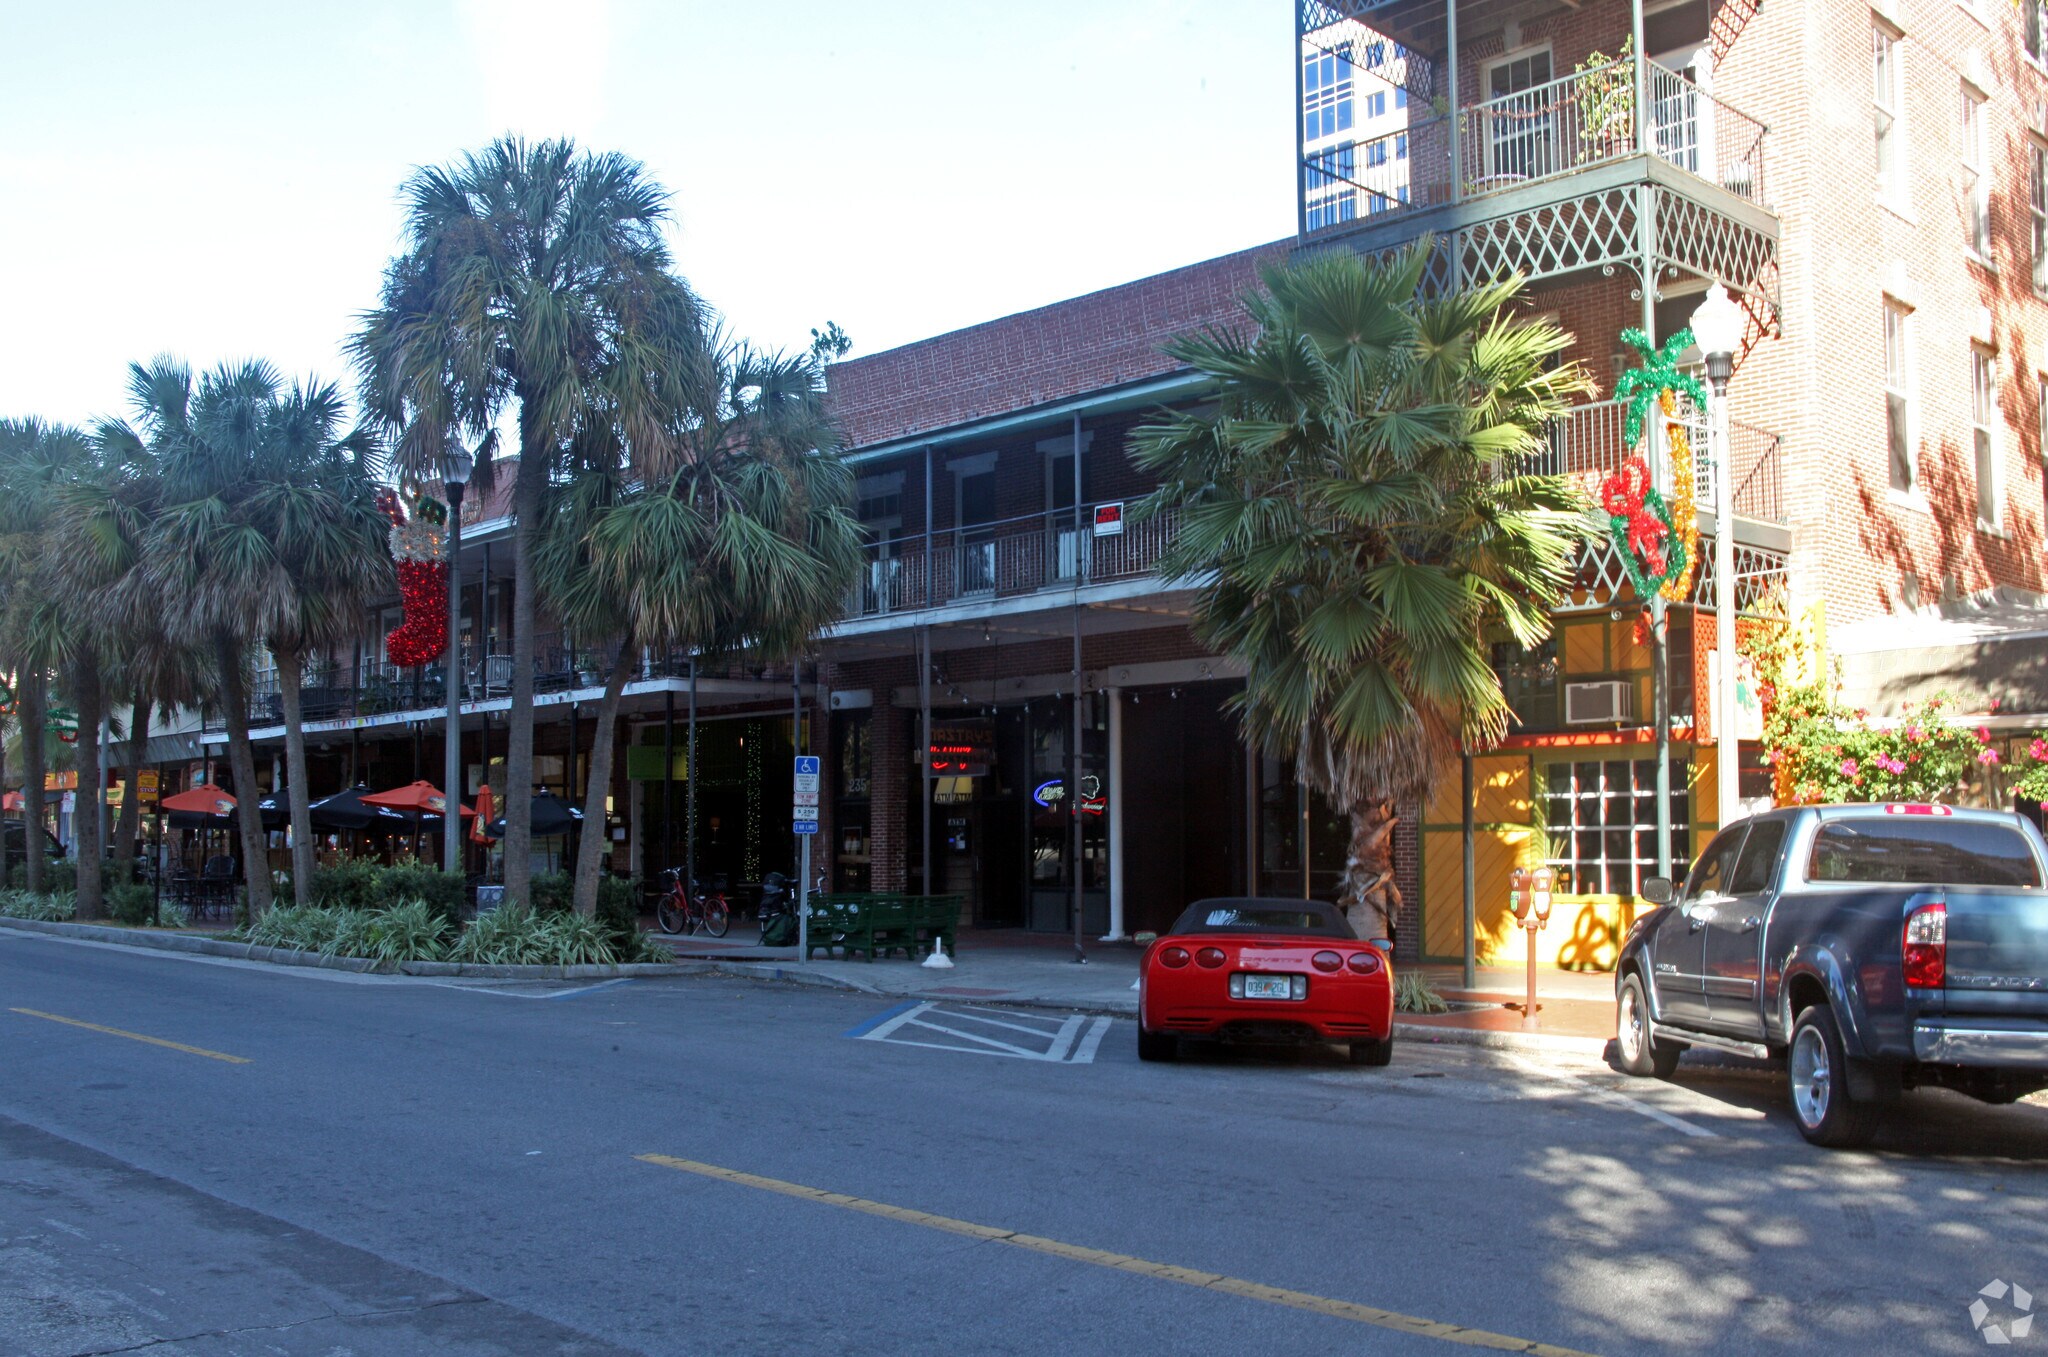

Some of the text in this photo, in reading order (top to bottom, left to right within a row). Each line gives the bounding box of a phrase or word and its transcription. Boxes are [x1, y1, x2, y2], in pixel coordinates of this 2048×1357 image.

[1101, 506, 1116, 515] FOR
[1097, 513, 1120, 523] RENT
[848, 778, 867, 792] 235
[936, 794, 951, 802] ATM
[954, 794, 971, 802] ATM
[948, 818, 966, 826] ATM
[1248, 982, 1263, 992] 039
